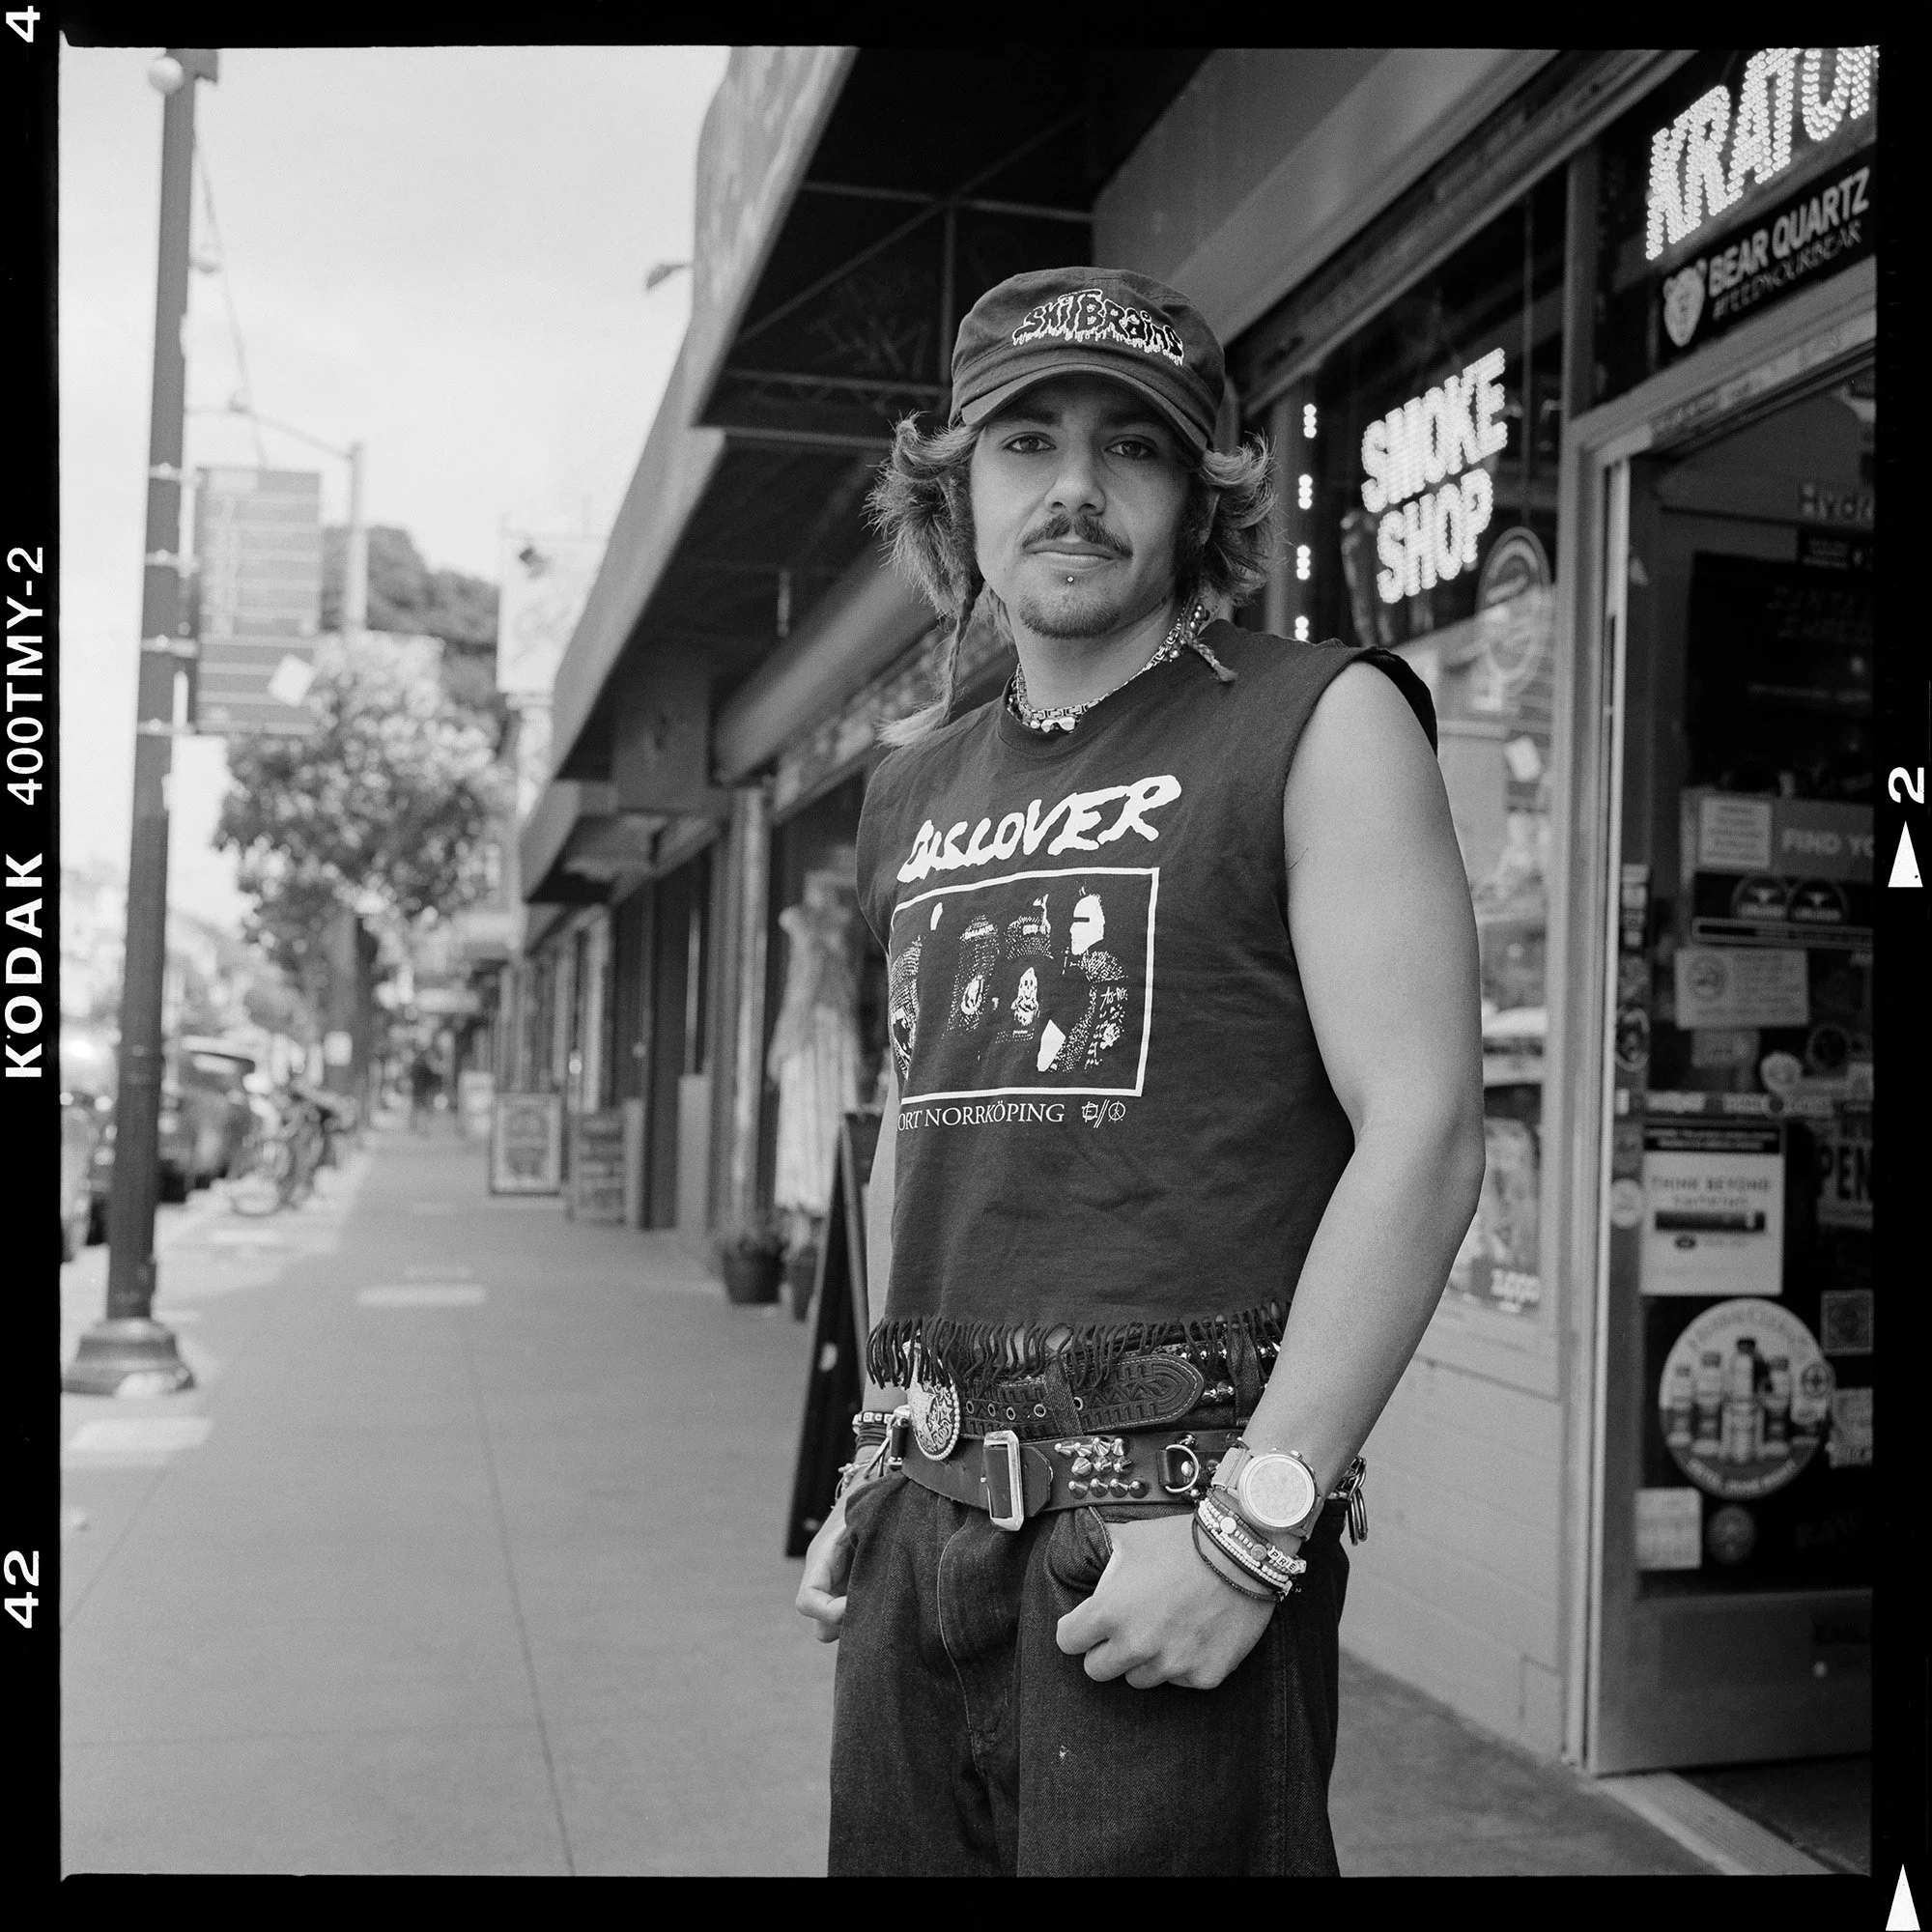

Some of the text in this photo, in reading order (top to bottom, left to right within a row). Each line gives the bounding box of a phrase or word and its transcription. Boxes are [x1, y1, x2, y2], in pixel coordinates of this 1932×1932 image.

[6, 5, 41, 43] 4
[1708, 167, 1871, 298] BEAR QUARTZ
[1361, 347, 1508, 513] SMOKE
[1377, 468, 1493, 605] SHOP
[5, 546, 44, 1079] KODAK 400TMY-2
[896, 774, 1182, 884] DISCOVER
[1887, 766, 1925, 805] 2
[896, 1099, 1065, 1132] ORT NORRKÖPING
[3, 1549, 41, 1630] 42
